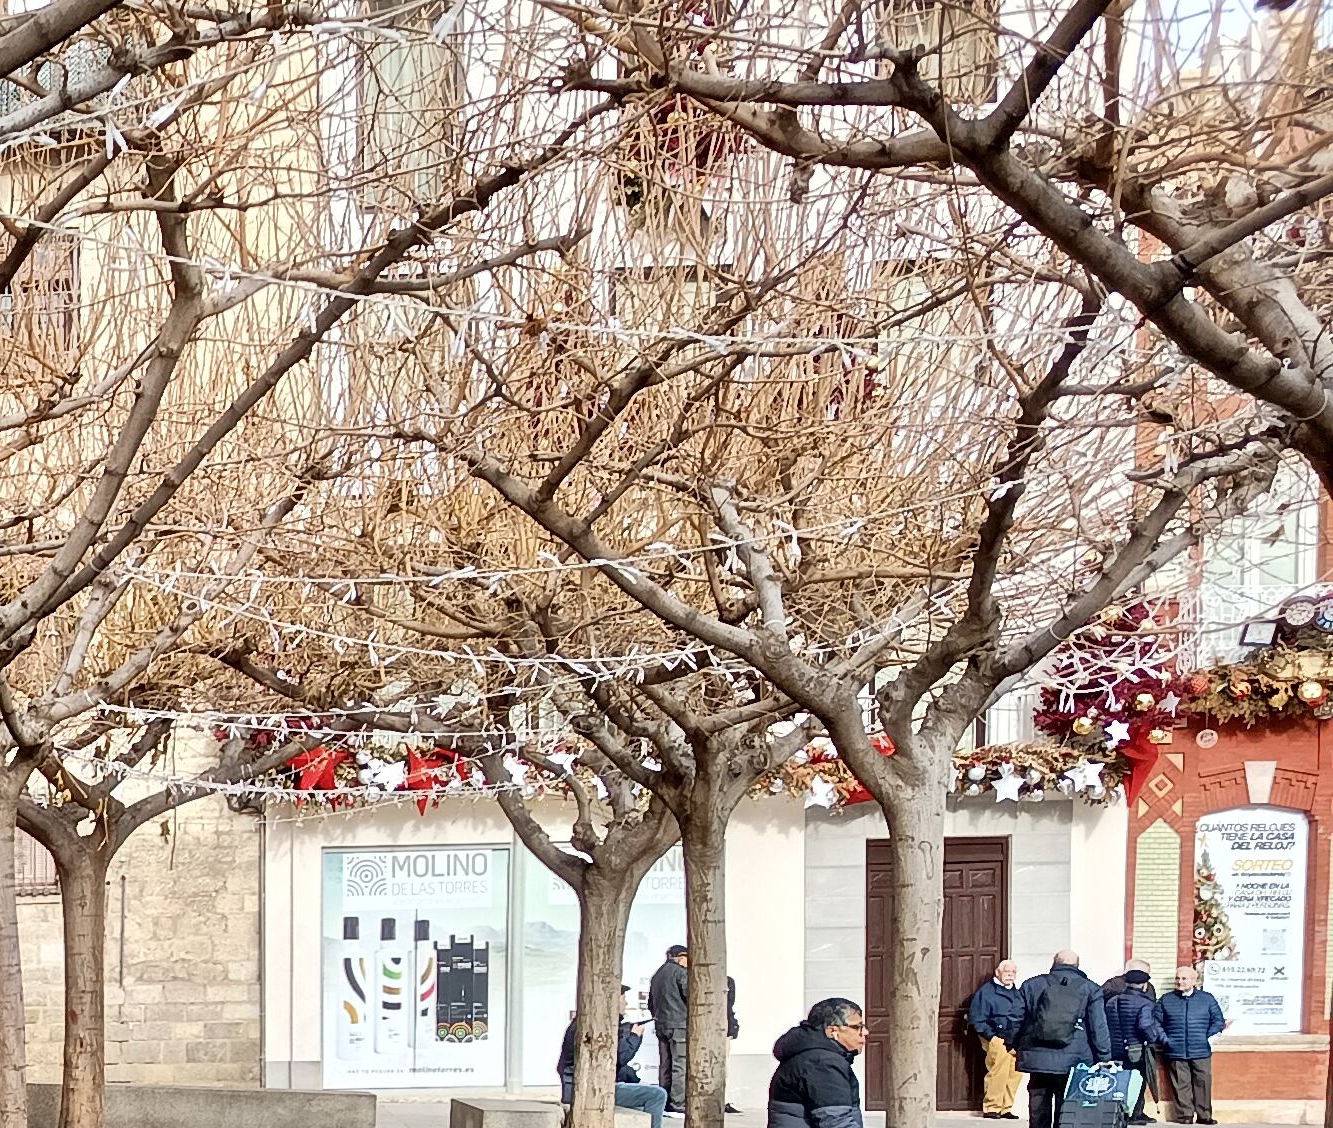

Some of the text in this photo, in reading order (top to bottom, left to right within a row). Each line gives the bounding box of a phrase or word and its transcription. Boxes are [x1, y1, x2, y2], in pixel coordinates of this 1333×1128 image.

[1250, 823, 1295, 832] RELOJES
[1221, 833, 1248, 841] TIENE
[1266, 832, 1295, 840] CASA
[1231, 841, 1295, 850] DEL RELOJ?
[391, 853, 488, 878] MOLINO
[1232, 860, 1293, 871] SORTEO
[391, 880, 488, 896] DE LAS TORRES
[646, 876, 684, 890] TORRE
